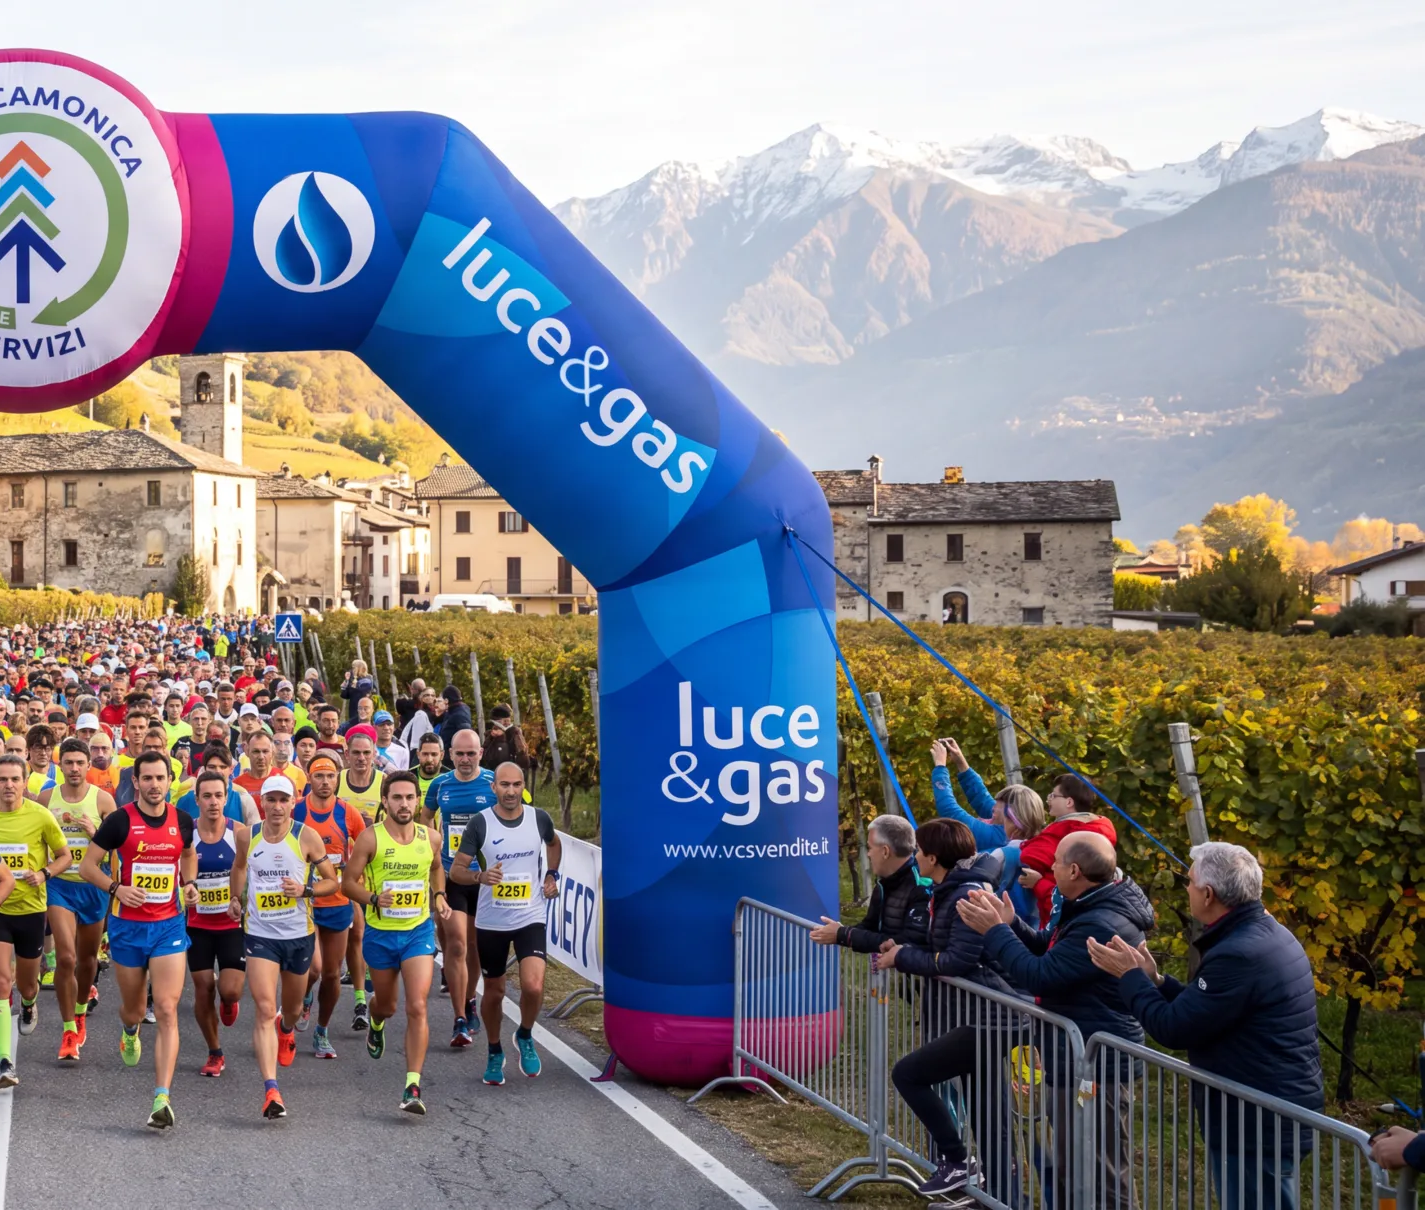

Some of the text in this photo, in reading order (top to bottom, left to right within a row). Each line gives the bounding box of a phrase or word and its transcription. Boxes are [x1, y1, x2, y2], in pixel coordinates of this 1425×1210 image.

[442, 217, 708, 494] luce&gas
[679, 681, 820, 749] luce
[661, 751, 825, 826] &gas
[136, 875, 169, 889] 2209
[663, 837, 829, 859] www.vcsvendite.it
